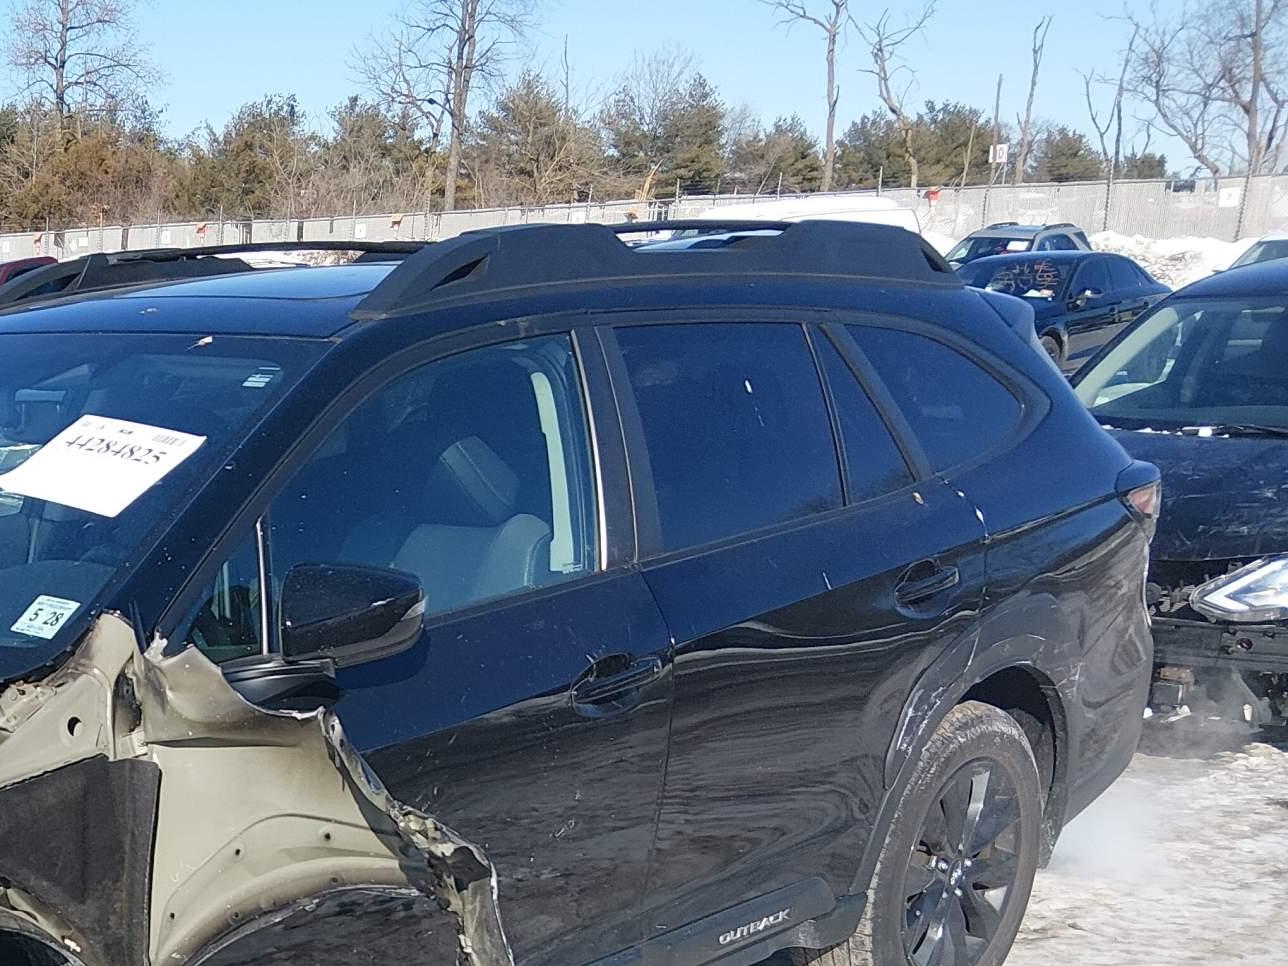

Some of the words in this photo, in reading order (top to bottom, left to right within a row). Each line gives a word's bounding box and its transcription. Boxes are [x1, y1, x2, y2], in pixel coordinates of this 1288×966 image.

[65, 435, 168, 465] 44284825
[28, 607, 44, 622] 5
[42, 611, 65, 627] 28
[718, 908, 791, 945] OUTBACK
